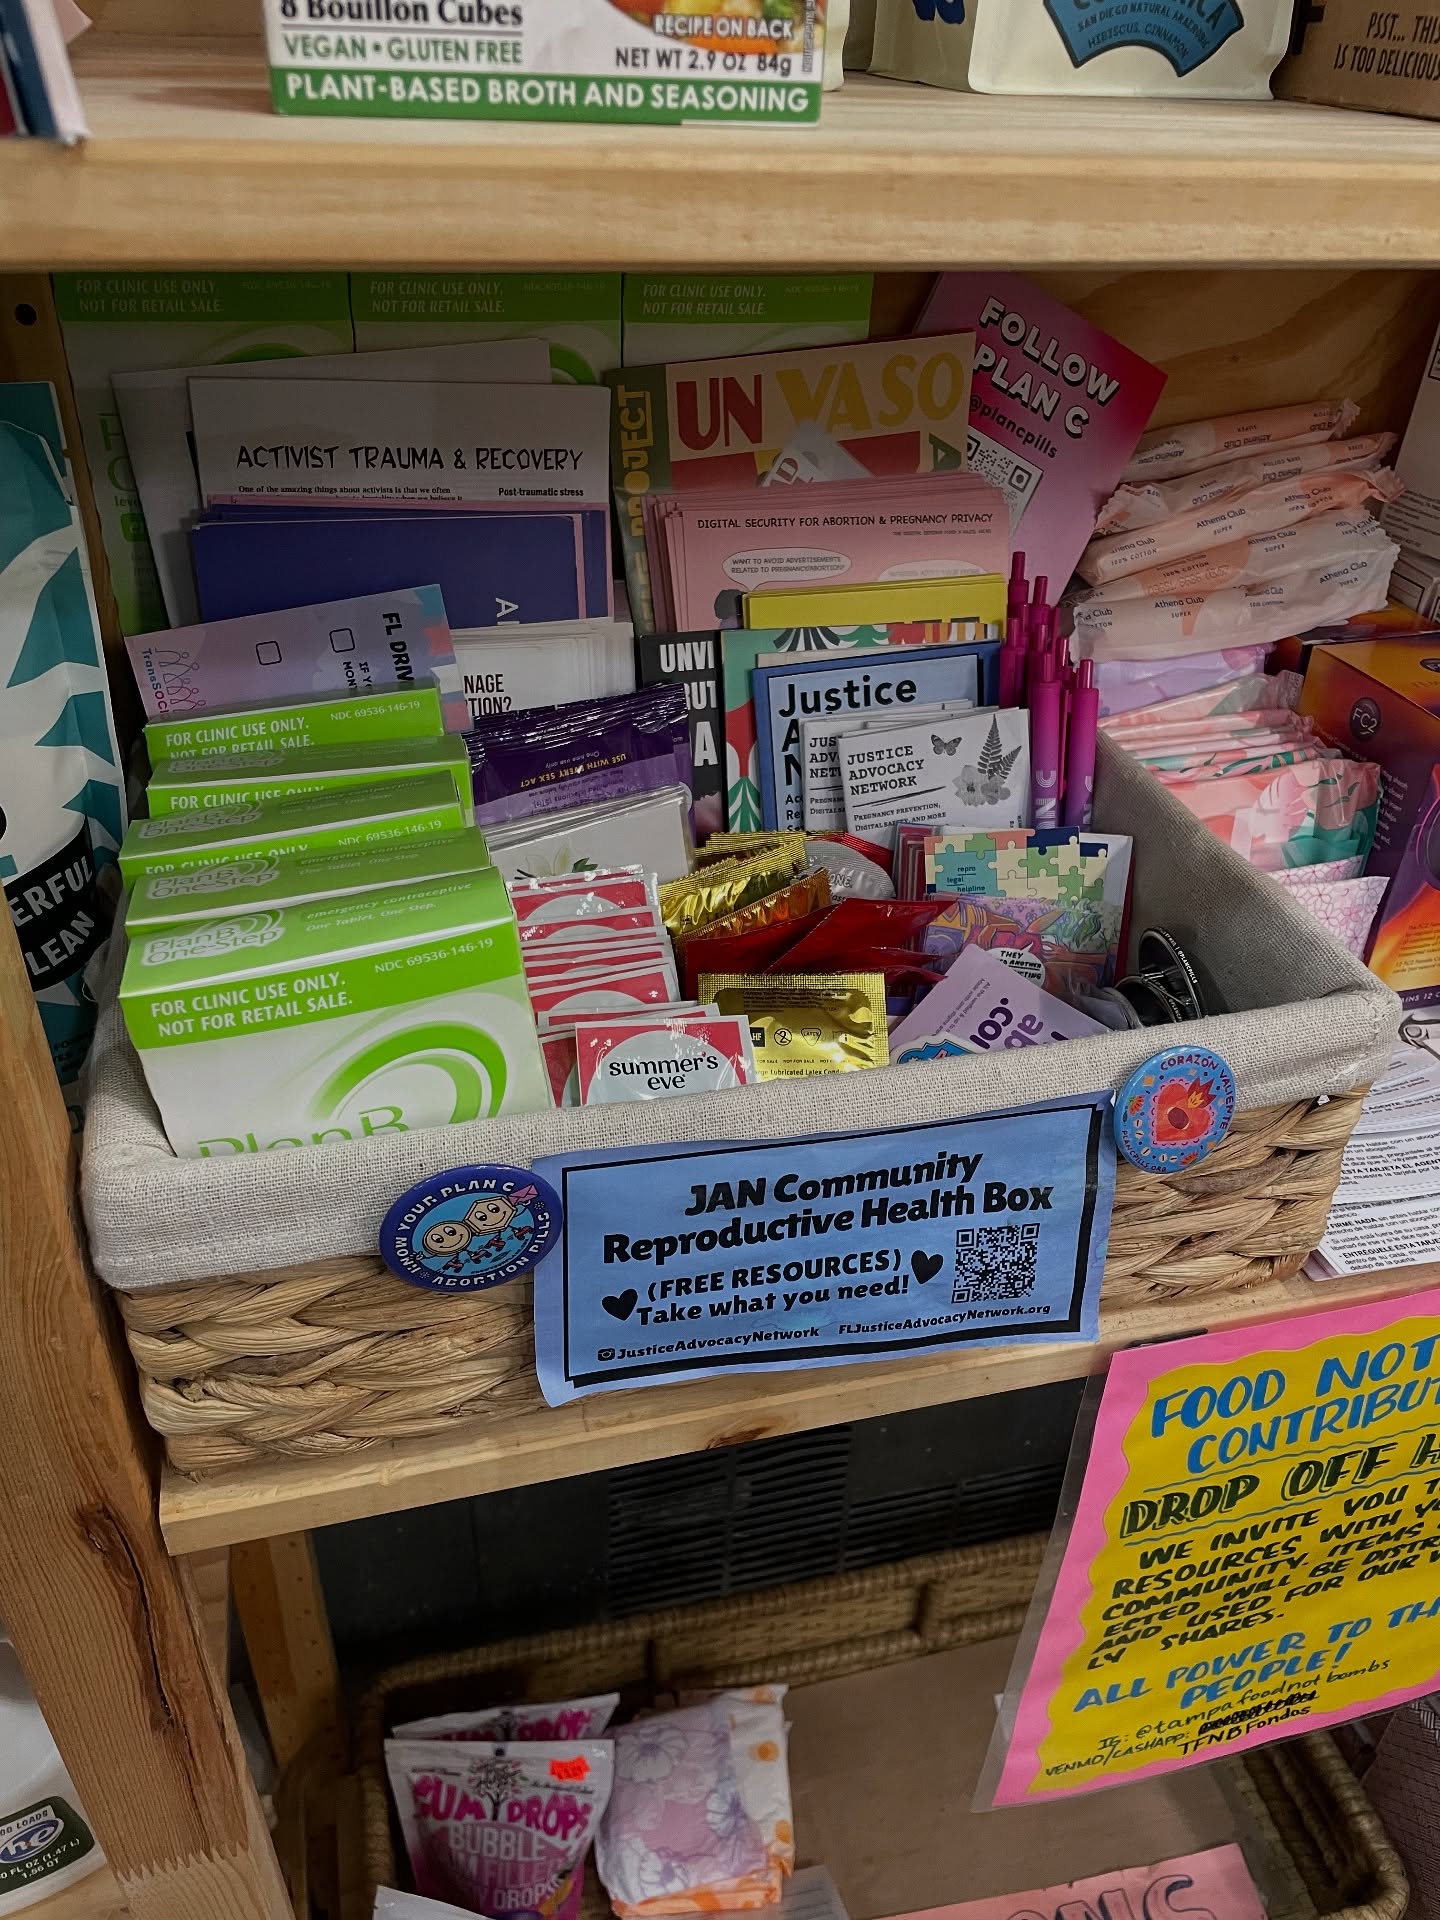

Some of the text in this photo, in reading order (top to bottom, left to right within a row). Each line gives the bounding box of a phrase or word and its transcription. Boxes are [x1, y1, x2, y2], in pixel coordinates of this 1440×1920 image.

[307, 0, 524, 25] Bouillon Cubes
[653, 14, 795, 39] RECIPE ON BACK
[1130, 3, 1170, 18] NATURAL
[283, 34, 523, 64] VEGAN GLUTEN FREE
[615, 47, 792, 77] NET WT 2.9 OZ 84g
[1333, 43, 1349, 70] IS
[1350, 46, 1376, 73] TOO
[286, 73, 809, 112] PLANT-BASED BROTH AND SEASONING
[643, 285, 732, 298] FOR CLINIC USE
[643, 302, 666, 315] NOT
[696, 302, 736, 315] RETAIL
[978, 295, 1120, 407] FOLLOW
[676, 352, 964, 451] UN VASO
[973, 343, 1090, 438] PLAN C
[970, 396, 1058, 458] @plancpills
[236, 445, 584, 471] ACTIVIST TRAUMA & RECOVERY
[238, 485, 253, 493] One
[256, 485, 263, 493] of
[265, 485, 278, 493] the
[281, 486, 312, 496] amazing
[315, 486, 337, 496] things
[340, 486, 360, 494] about
[362, 486, 393, 495] activists
[432, 487, 450, 495] often
[498, 487, 584, 497] Post-traumatic stress
[697, 513, 993, 529] DIGITAL SECURITY FOR ABORTION & PREGNANCY PRIVACY
[1195, 507, 1247, 529] Athena Club
[1154, 595, 1205, 610] Athena Club
[330, 699, 422, 723] NDC 69536-146-19
[779, 674, 917, 717] Justice
[166, 716, 311, 748] FOR CLINIC USE ONLY.
[1352, 706, 1378, 733] FC2
[520, 753, 626, 788] USE WITH SEX ACT
[847, 745, 914, 766] JUSTICE
[848, 758, 925, 781] ADVOCACY
[849, 775, 918, 797] NETWORK
[946, 876, 964, 885] legal
[957, 866, 976, 874] repro
[957, 885, 986, 893] helpline
[306, 882, 473, 921] emergency contraceptive
[25, 910, 96, 977] LEAN
[374, 937, 495, 974] NDC 69536-146-19
[151, 970, 347, 1018] FOR CLINIC USE ONLY.
[158, 990, 354, 1038] NOT FOR RETAIL SALE.
[609, 1050, 719, 1078] summer's
[647, 1076, 686, 1091] eve
[1218, 1067, 1235, 1131] VALIENTE
[685, 1150, 984, 1217] JAN Community
[395, 1179, 515, 1275] KNOW YOUR PLAN C
[528, 1210, 552, 1255] PILLS
[603, 1181, 1055, 1266] Reproductive Health Box
[648, 1248, 902, 1302] (FREE RESOURCES)
[636, 1273, 910, 1327] Take what you need!
[617, 1304, 1052, 1360] JusticeAdvocacyNetwork FLJusticeAdvocacyNetwork.org
[1151, 1334, 1440, 1439] FOOD NOT
[1119, 1441, 1400, 1540] DROP OFF
[1139, 1484, 1410, 1571] WE INVITE YOU
[1102, 1521, 1426, 1622] COMMUNITY. ITEMS
[1111, 1508, 1404, 1600] RESOURCES WITH
[1092, 1552, 1424, 1655] AND USED FOR OUR
[1102, 1557, 1355, 1639] ECTED WILL BE
[1086, 1607, 1286, 1671] LY SHARES.
[1072, 1616, 1373, 1714] ALL POWER TO
[1180, 1641, 1354, 1710] PEOPLE!
[16, 1808, 50, 1831] LOADS
[447, 1823, 546, 1862] BUBBLE
